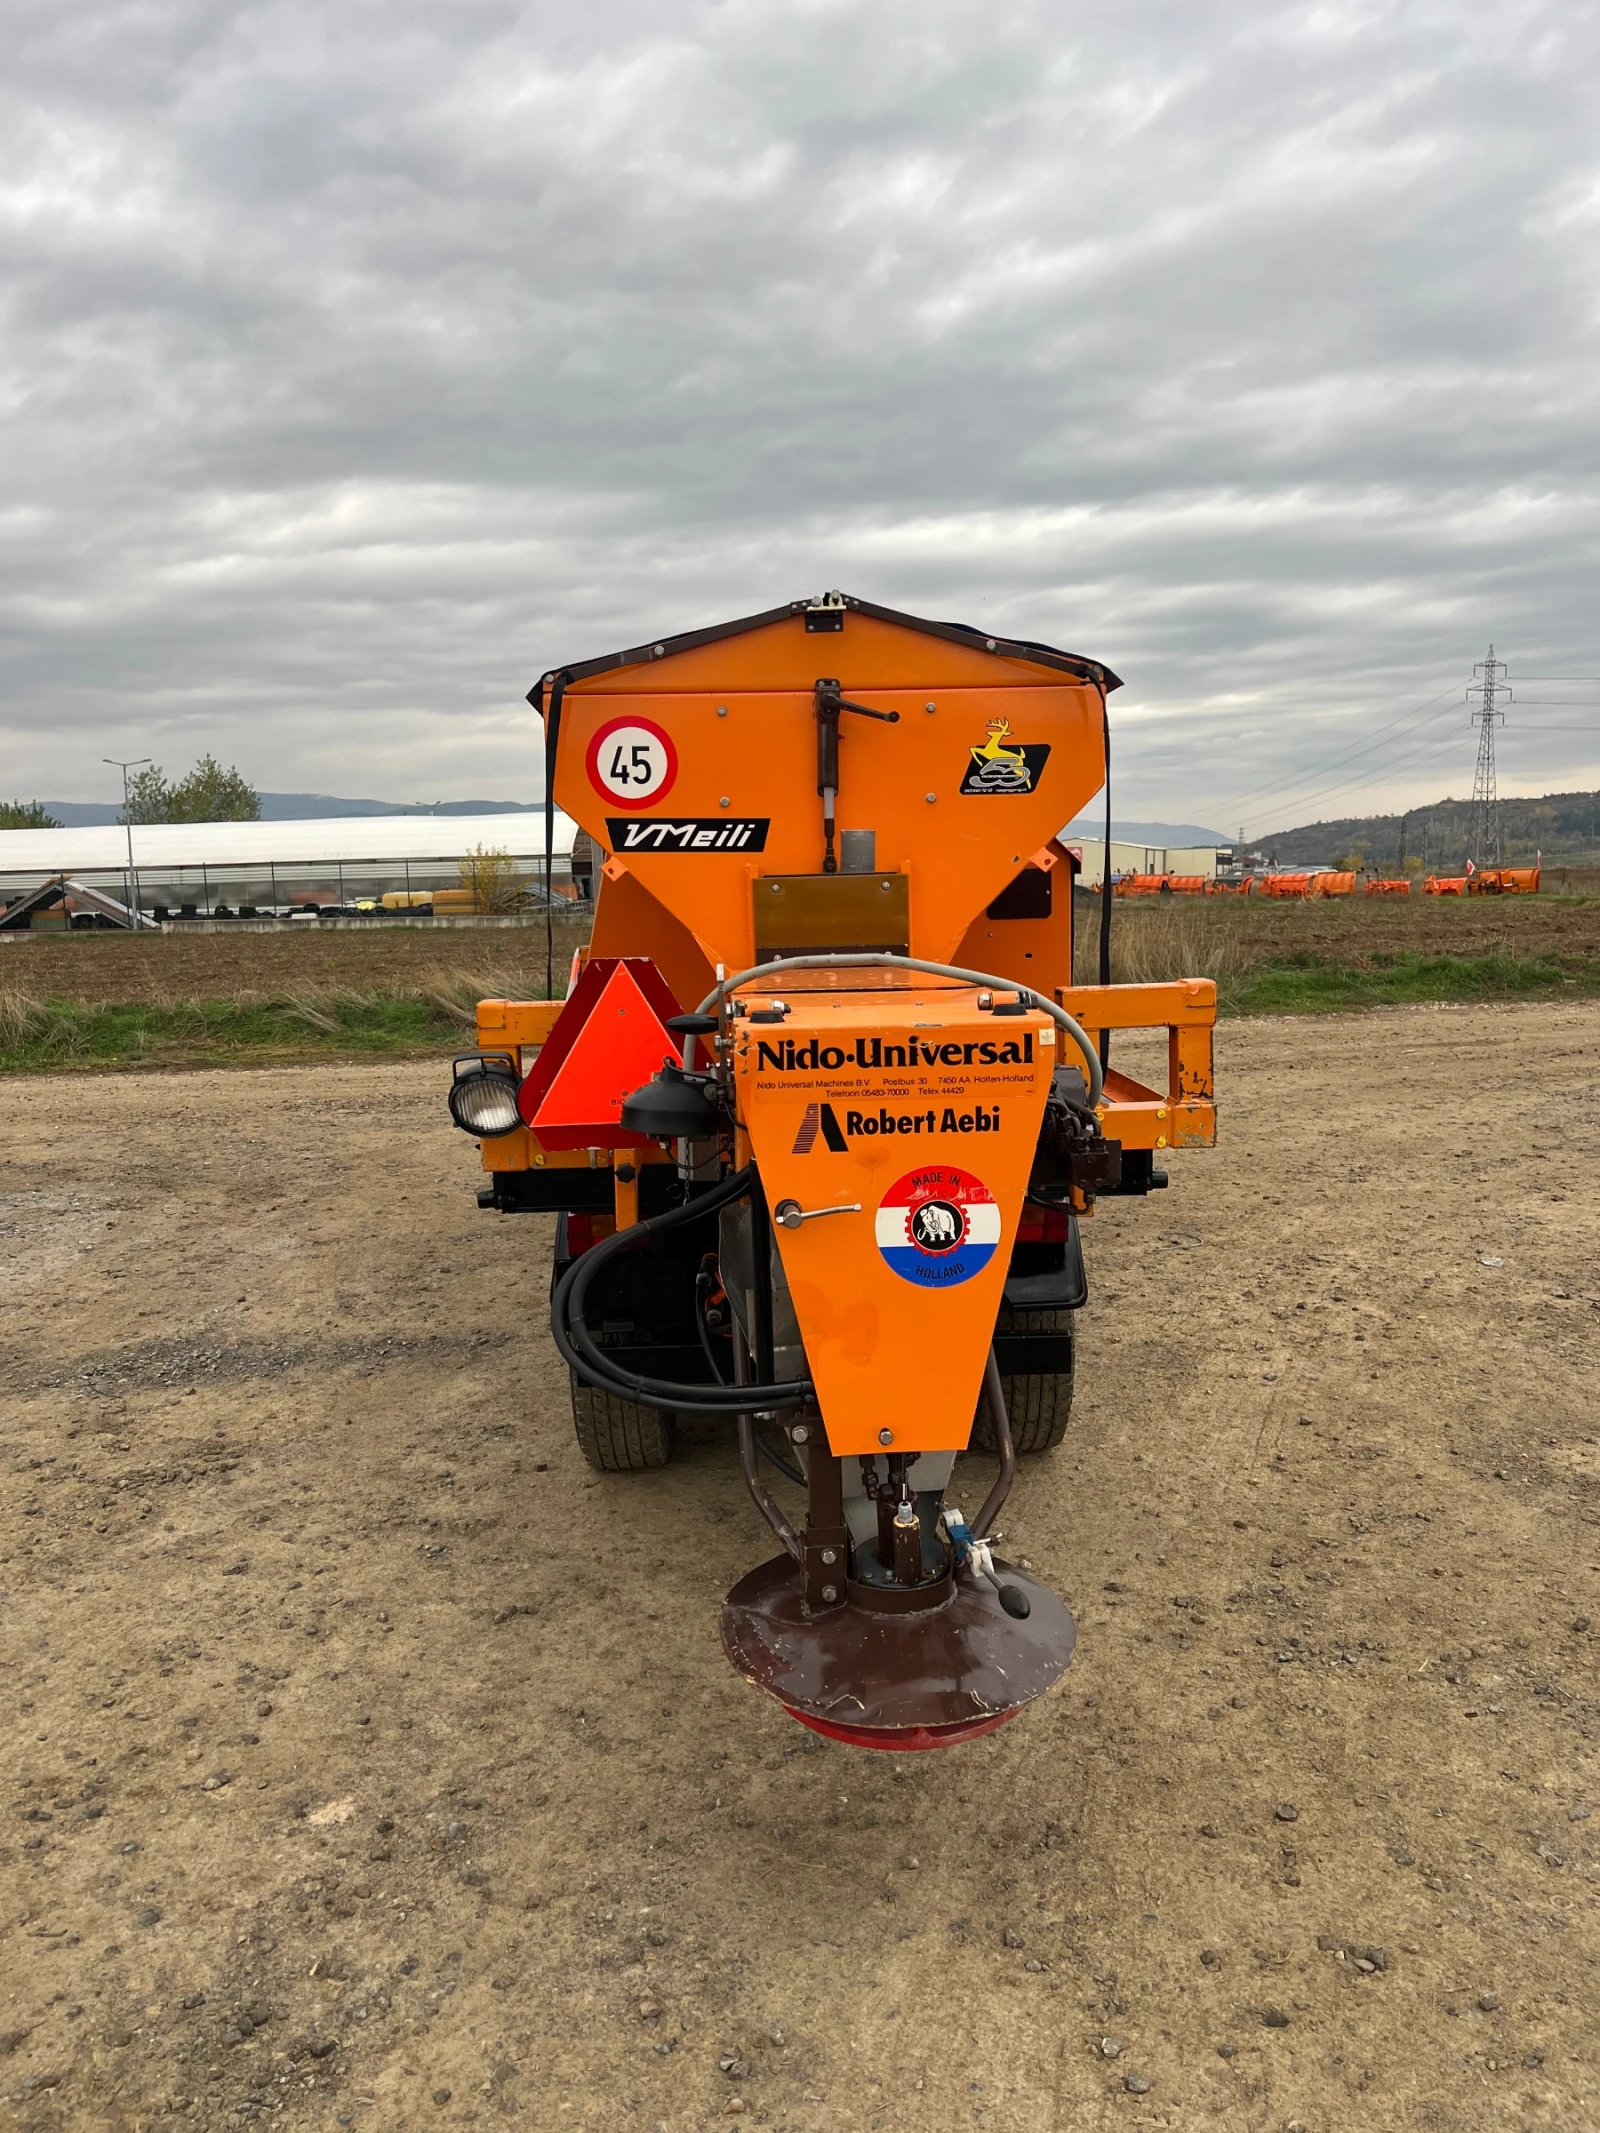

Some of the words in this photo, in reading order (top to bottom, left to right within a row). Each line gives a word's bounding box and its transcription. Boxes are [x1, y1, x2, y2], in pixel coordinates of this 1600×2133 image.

[610, 746, 652, 785] 45
[757, 1082, 776, 1090] Nido
[778, 1081, 814, 1089] Universal
[815, 1079, 854, 1088] Machines
[856, 1079, 872, 1087] B.V.
[883, 1078, 915, 1086] Postbus
[917, 1077, 928, 1085] 30
[938, 1076, 957, 1085] 7450
[958, 1076, 971, 1084] AA
[974, 1074, 1034, 1084] Holten-Holland
[826, 1089, 860, 1098] Telefoon
[861, 1088, 910, 1097] 05483-70000
[918, 1087, 940, 1095] Telex
[941, 1086, 965, 1095] 44429
[847, 1108, 936, 1135] Robert
[940, 1106, 1000, 1132] Aebi
[911, 1172, 943, 1188] MADE
[948, 1174, 961, 1186] IN
[915, 1262, 965, 1279] HOLLAND
